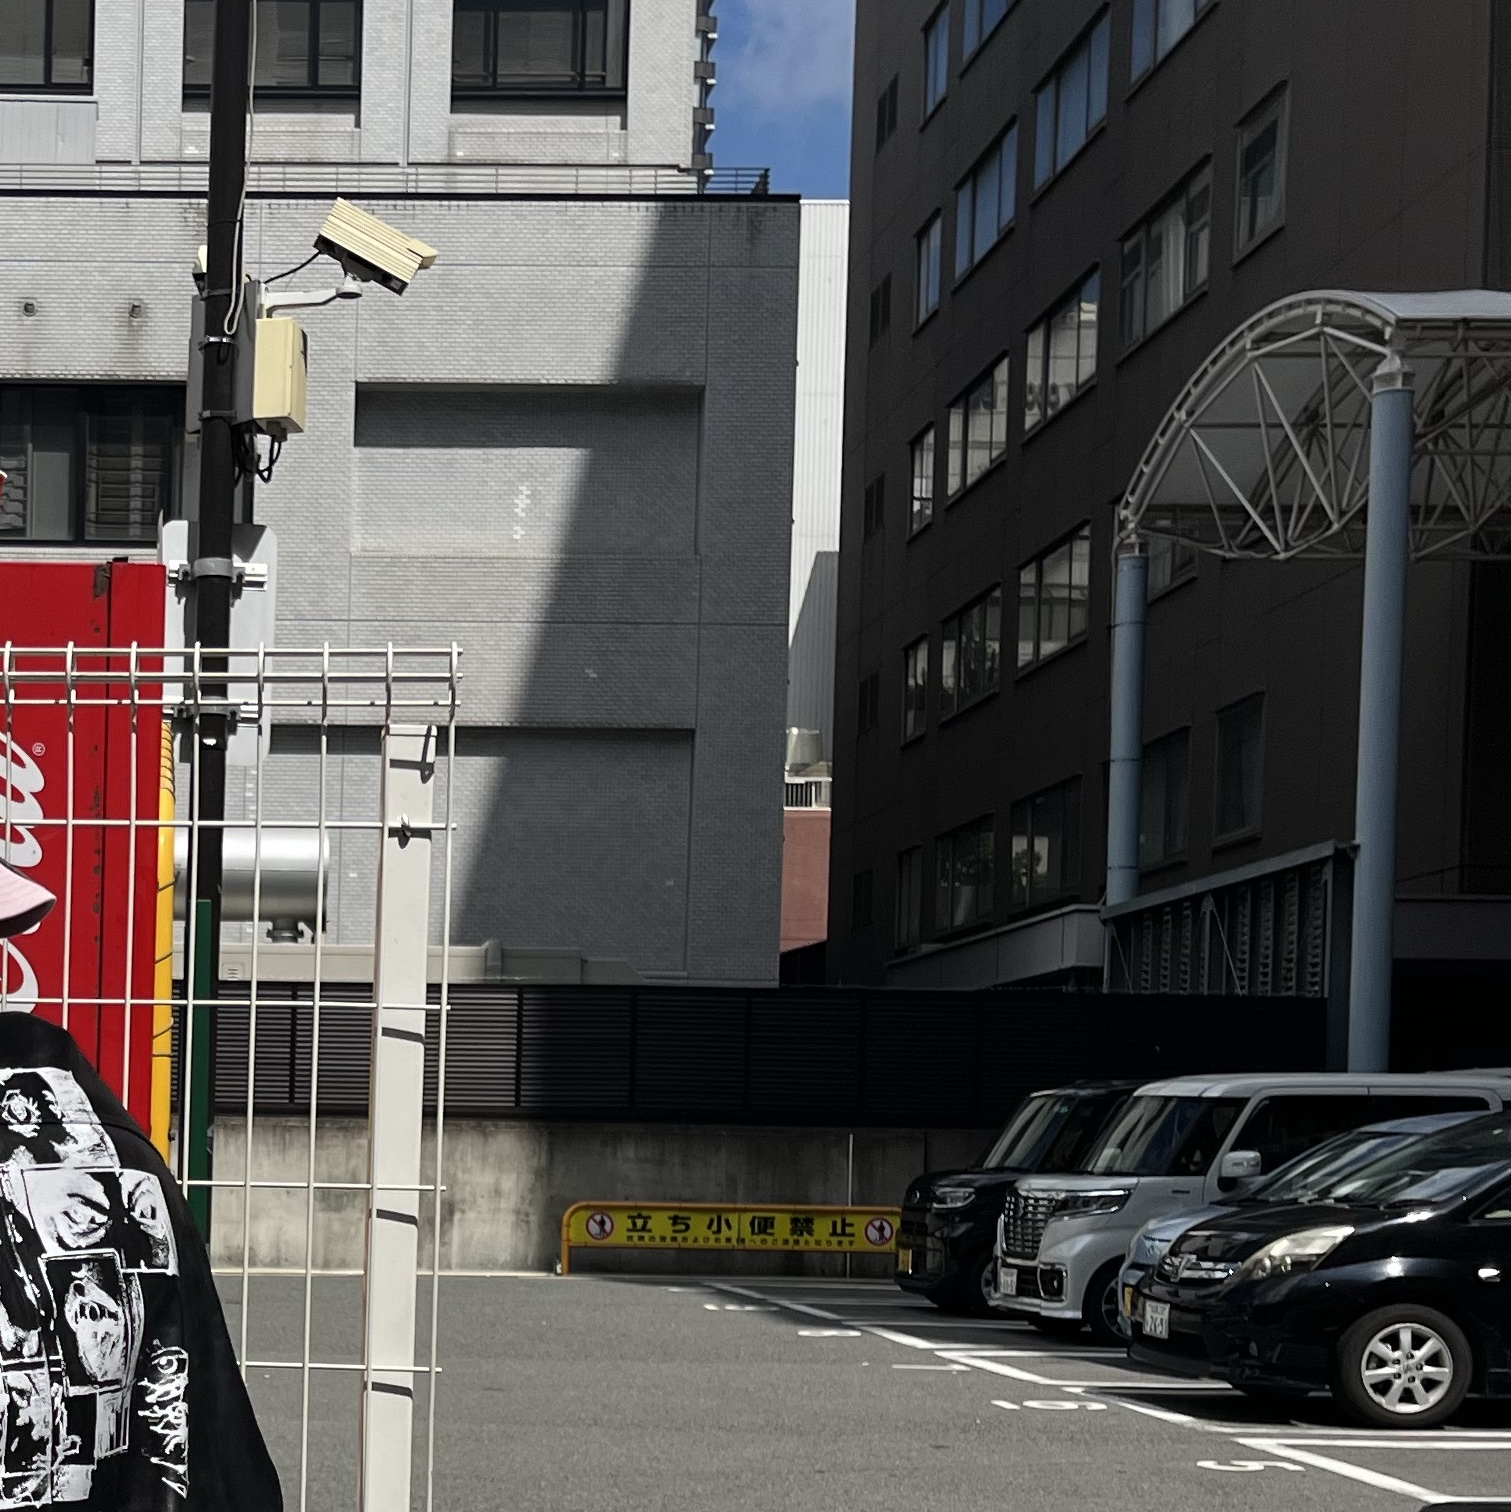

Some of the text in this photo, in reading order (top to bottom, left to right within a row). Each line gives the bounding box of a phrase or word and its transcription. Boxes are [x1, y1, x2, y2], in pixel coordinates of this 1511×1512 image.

[626, 1213, 856, 1238] 立ち小便禁止
